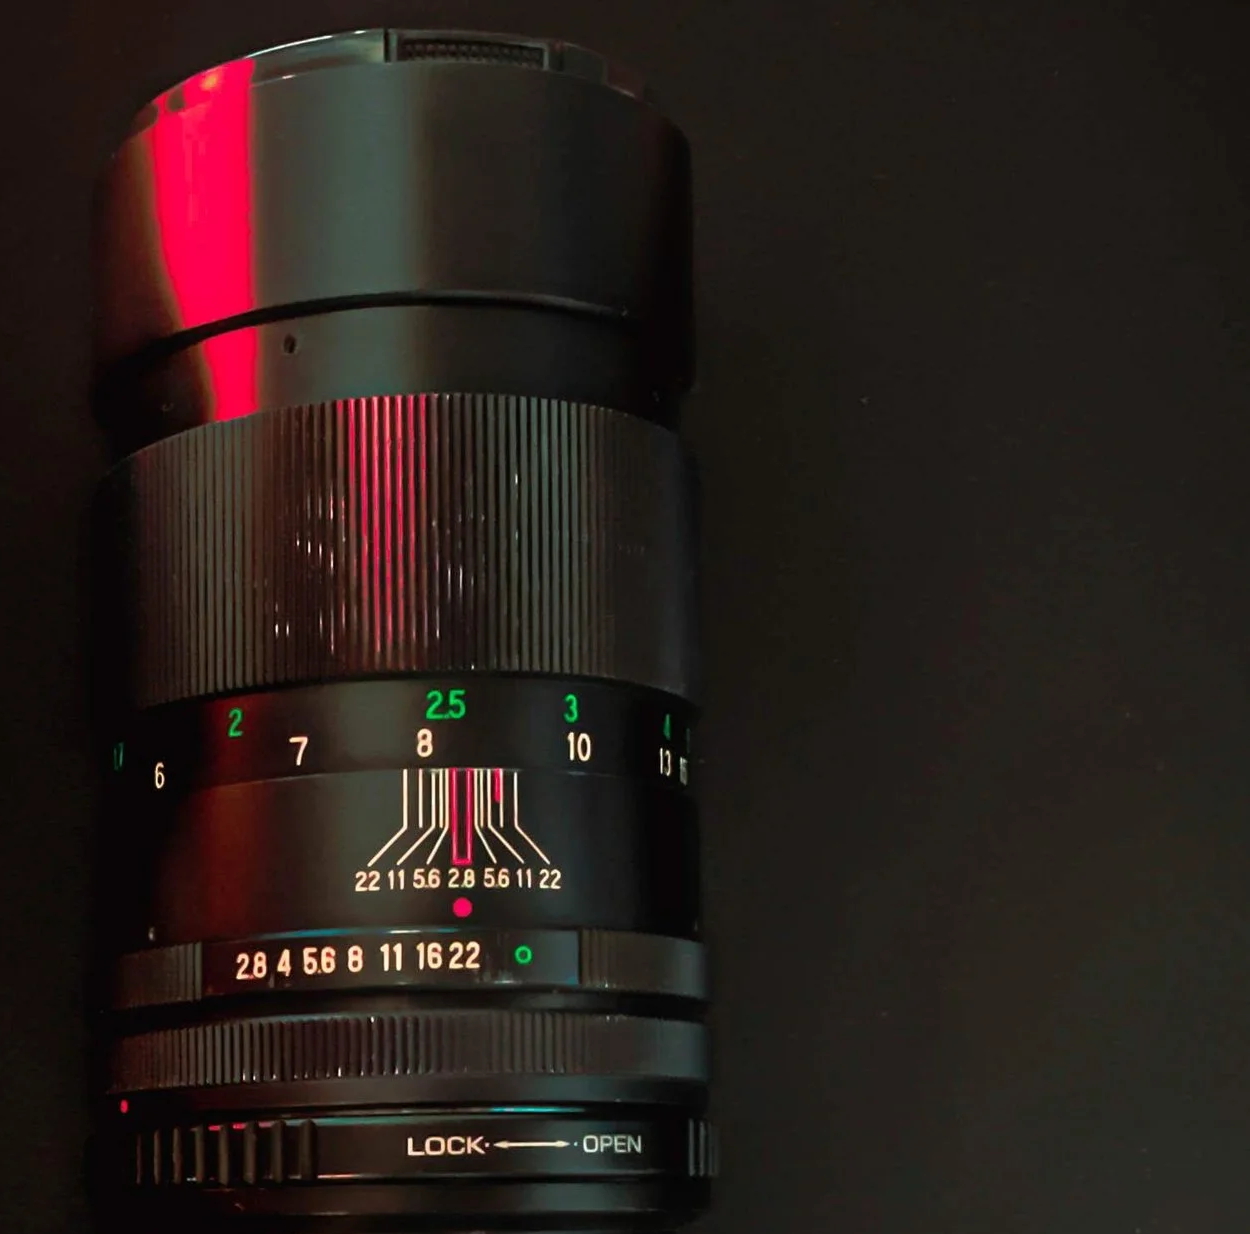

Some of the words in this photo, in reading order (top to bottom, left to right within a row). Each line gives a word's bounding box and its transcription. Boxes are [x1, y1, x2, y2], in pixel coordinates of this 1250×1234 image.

[228, 707, 243, 738] 2
[425, 689, 467, 720] 2.5
[564, 694, 579, 723] 3
[154, 761, 165, 789] 6
[289, 736, 308, 766] 7
[417, 728, 433, 758] 8
[567, 731, 591, 762] 10
[659, 747, 671, 777] 13
[355, 870, 381, 892] 22
[388, 869, 405, 890] 11
[412, 868, 441, 889] 5.6
[448, 868, 476, 889] 2.8
[483, 867, 510, 889] 5.6
[516, 868, 532, 889] 11
[539, 868, 562, 890] 22
[236, 951, 267, 980] 2.8
[277, 949, 291, 977] 4
[303, 946, 336, 976] 5.6
[348, 945, 363, 973] 8
[380, 943, 403, 971] 11
[416, 942, 442, 970] 16
[449, 941, 480, 970] 22
[407, 1136, 485, 1156] LOCK
[583, 1134, 642, 1154] OPEN
